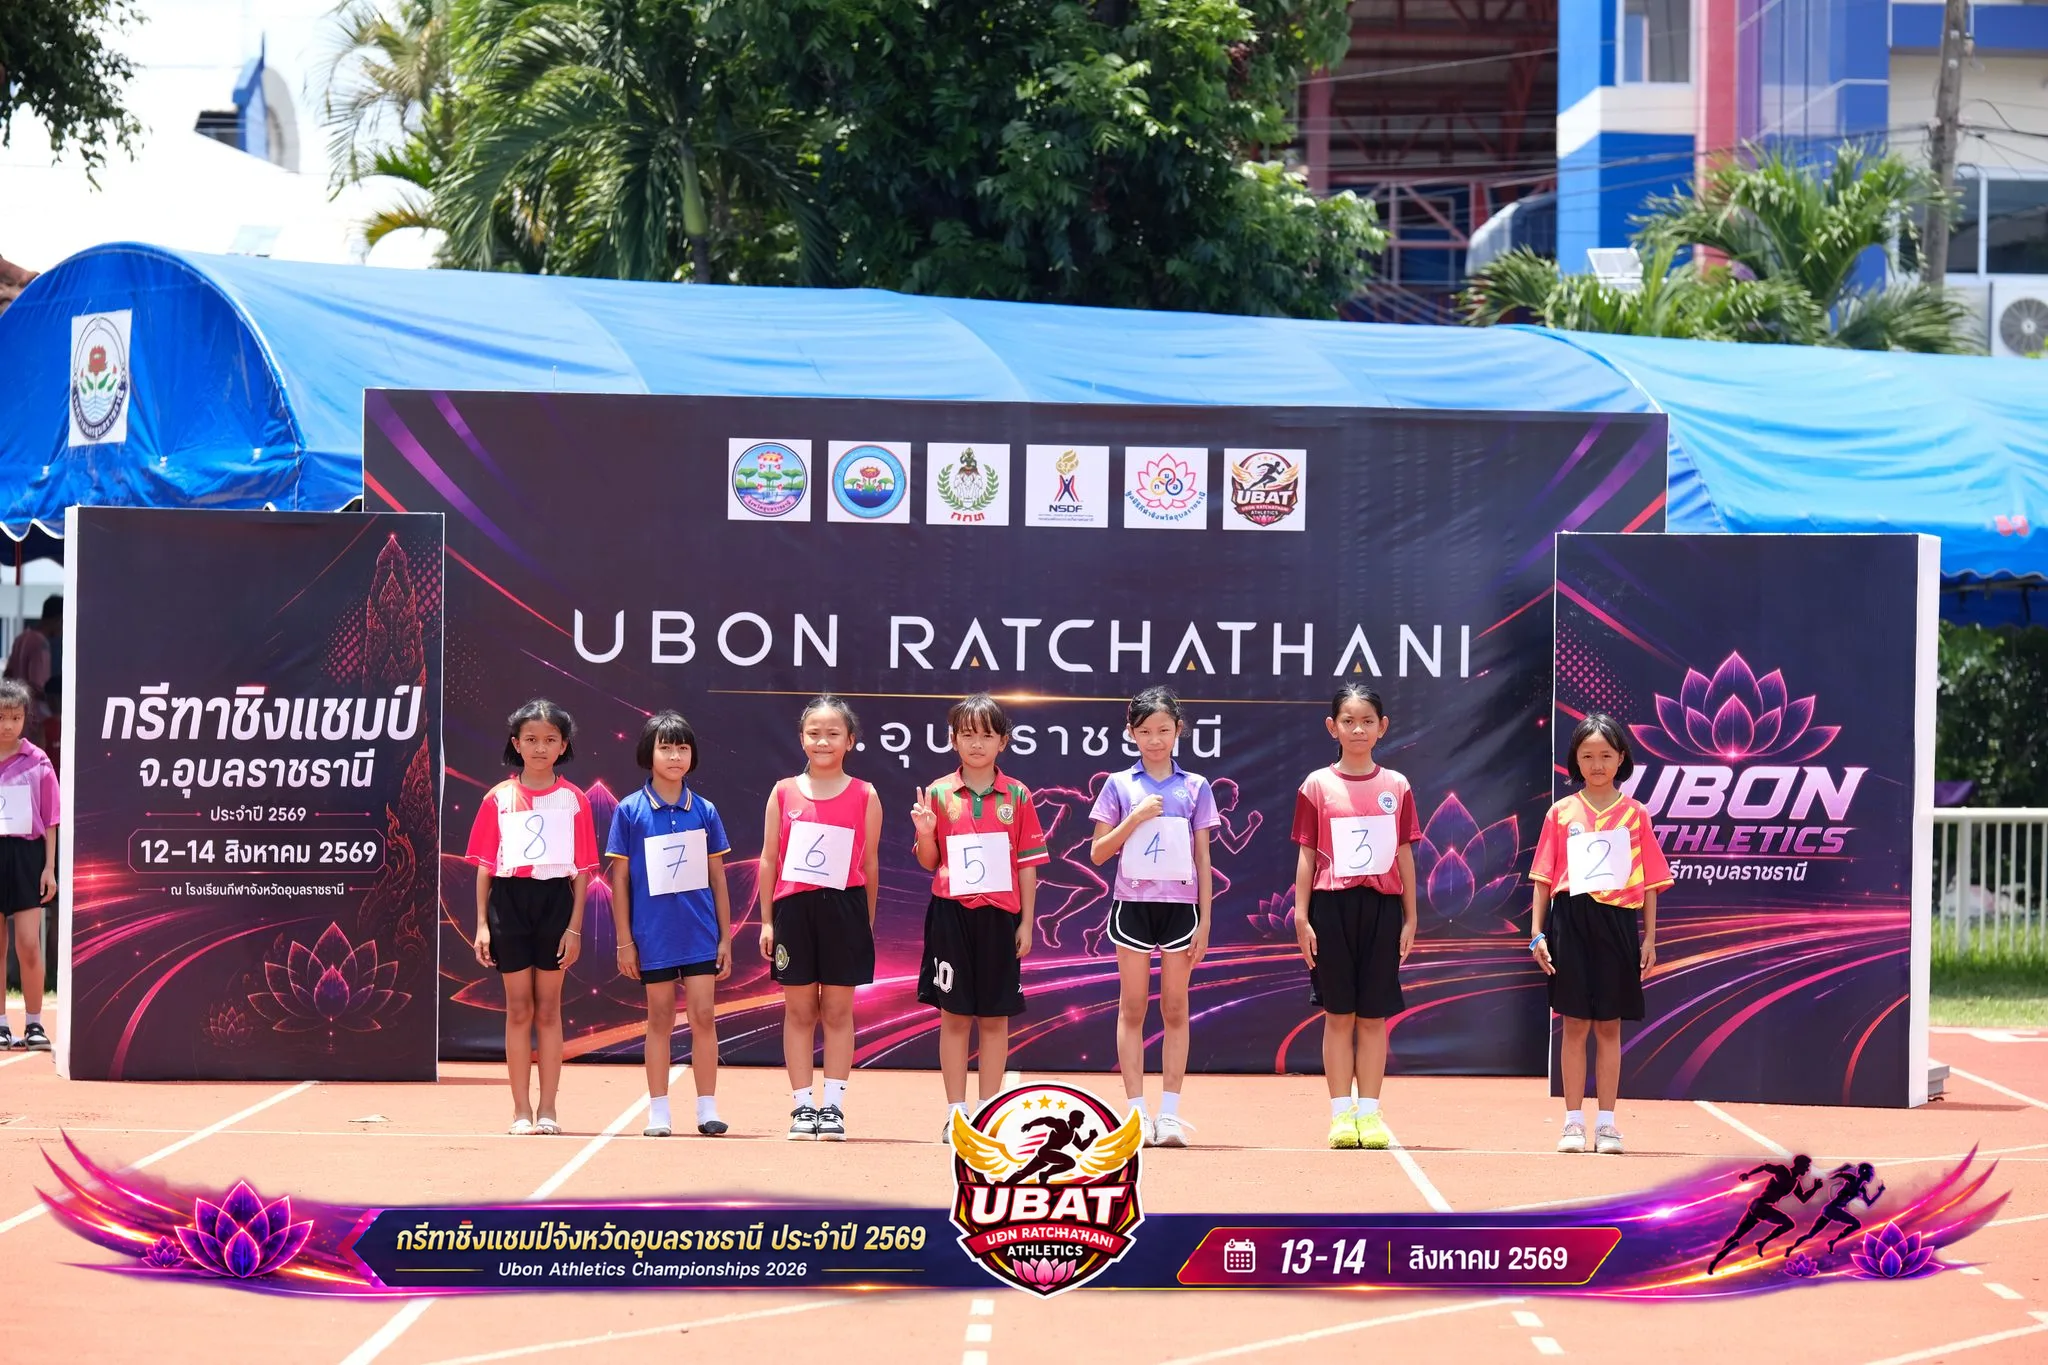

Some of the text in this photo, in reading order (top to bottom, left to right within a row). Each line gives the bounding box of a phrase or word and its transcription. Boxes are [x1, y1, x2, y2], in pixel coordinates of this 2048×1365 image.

[1049, 504, 1083, 513] NSDF
[1236, 490, 1294, 505] UBAT
[574, 608, 1470, 678] UBON RATCHATHANI
[101, 682, 423, 741] กรีฑาชิงแชมป์
[139, 748, 375, 799] จ.อุบลราชธานี
[210, 804, 307, 822] ประจำปี 2569
[140, 839, 377, 864] 12-14 สิงหาคม 2569
[523, 814, 546, 860] 8
[805, 833, 826, 869] 6
[1143, 831, 1165, 863] 4
[1349, 829, 1373, 869] 3
[1652, 825, 1853, 853] THLETICS
[662, 844, 688, 879] 7
[963, 845, 985, 885] 5
[1583, 839, 1614, 880] 2
[1669, 860, 1808, 886] รีฑาอุบลราชธานี
[170, 882, 344, 899] ณ โรงเรียนกีฬาจังหวัดอุบลราชธานี
